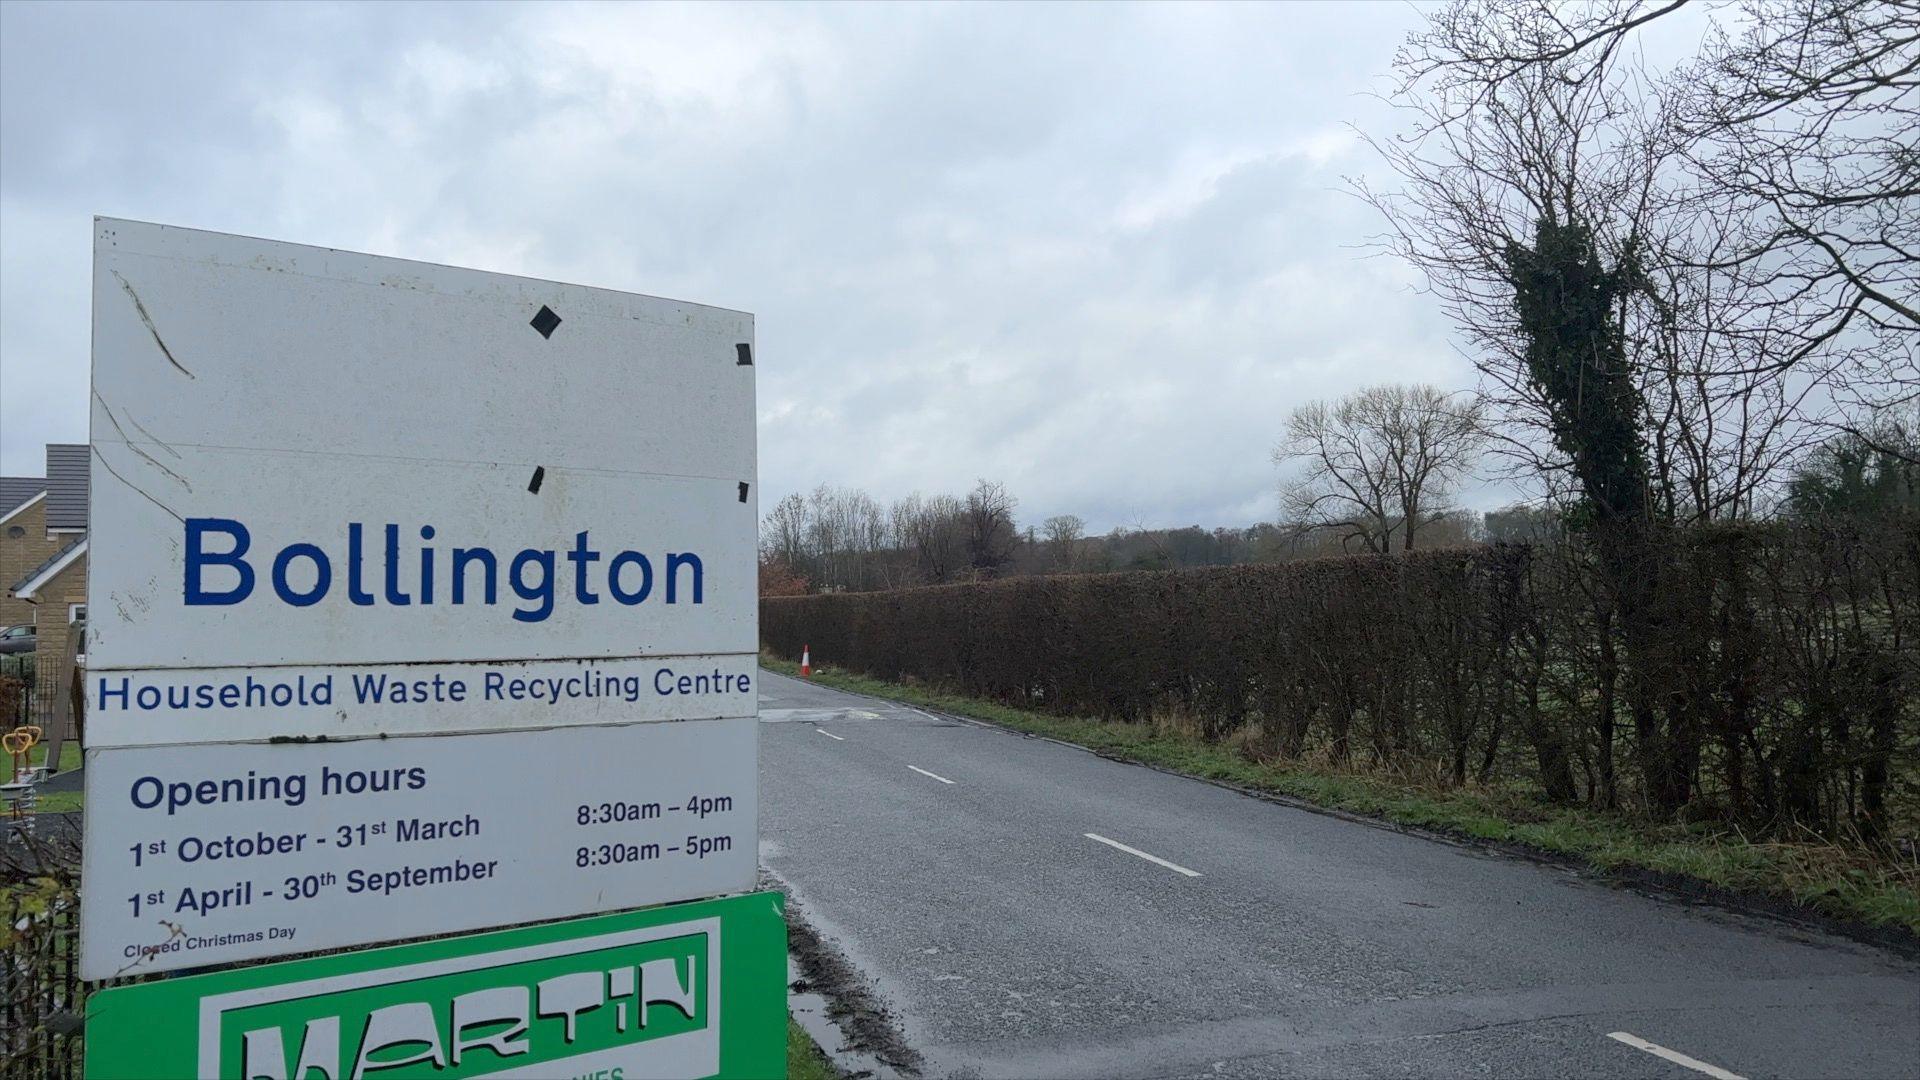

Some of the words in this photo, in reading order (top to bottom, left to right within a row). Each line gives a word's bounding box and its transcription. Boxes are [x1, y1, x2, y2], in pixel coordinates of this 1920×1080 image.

[183, 517, 704, 623] Bollington
[98, 675, 333, 711] Household
[352, 672, 467, 703] Waste
[484, 670, 640, 705] Recycling
[653, 667, 752, 696] Centre
[130, 770, 307, 815] Opening
[321, 765, 427, 796] hours
[577, 801, 661, 826] 8:30am
[686, 795, 733, 819] 4pm
[129, 840, 167, 867] 1st
[177, 831, 307, 863] October
[336, 820, 387, 848] 31st
[396, 814, 480, 843] March
[575, 842, 660, 868] 8:30am
[685, 835, 732, 859] 5pm
[127, 889, 166, 918] 1st
[174, 880, 252, 917] April
[283, 871, 337, 901] 30th
[346, 859, 498, 895] September
[186, 930, 264, 951] Christmas
[268, 927, 297, 941] Day
